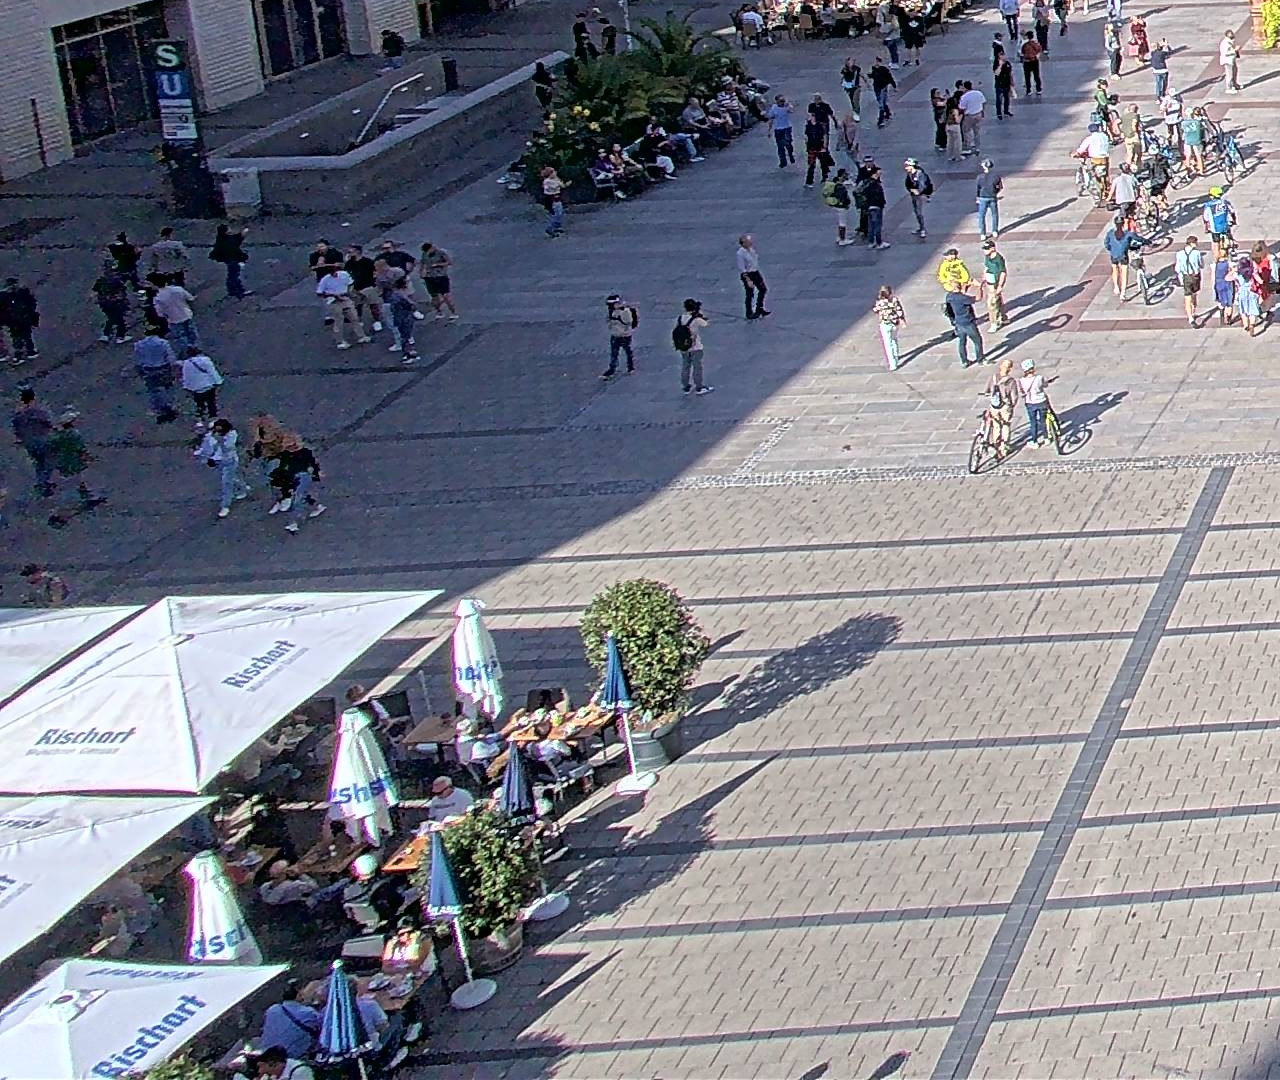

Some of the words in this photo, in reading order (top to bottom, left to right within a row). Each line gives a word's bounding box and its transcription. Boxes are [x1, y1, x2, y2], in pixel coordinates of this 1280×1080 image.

[157, 44, 179, 67] S
[160, 74, 181, 96] U
[221, 640, 296, 689] Rischart
[34, 727, 137, 746] Rischart
[91, 993, 207, 1080] Rischart
